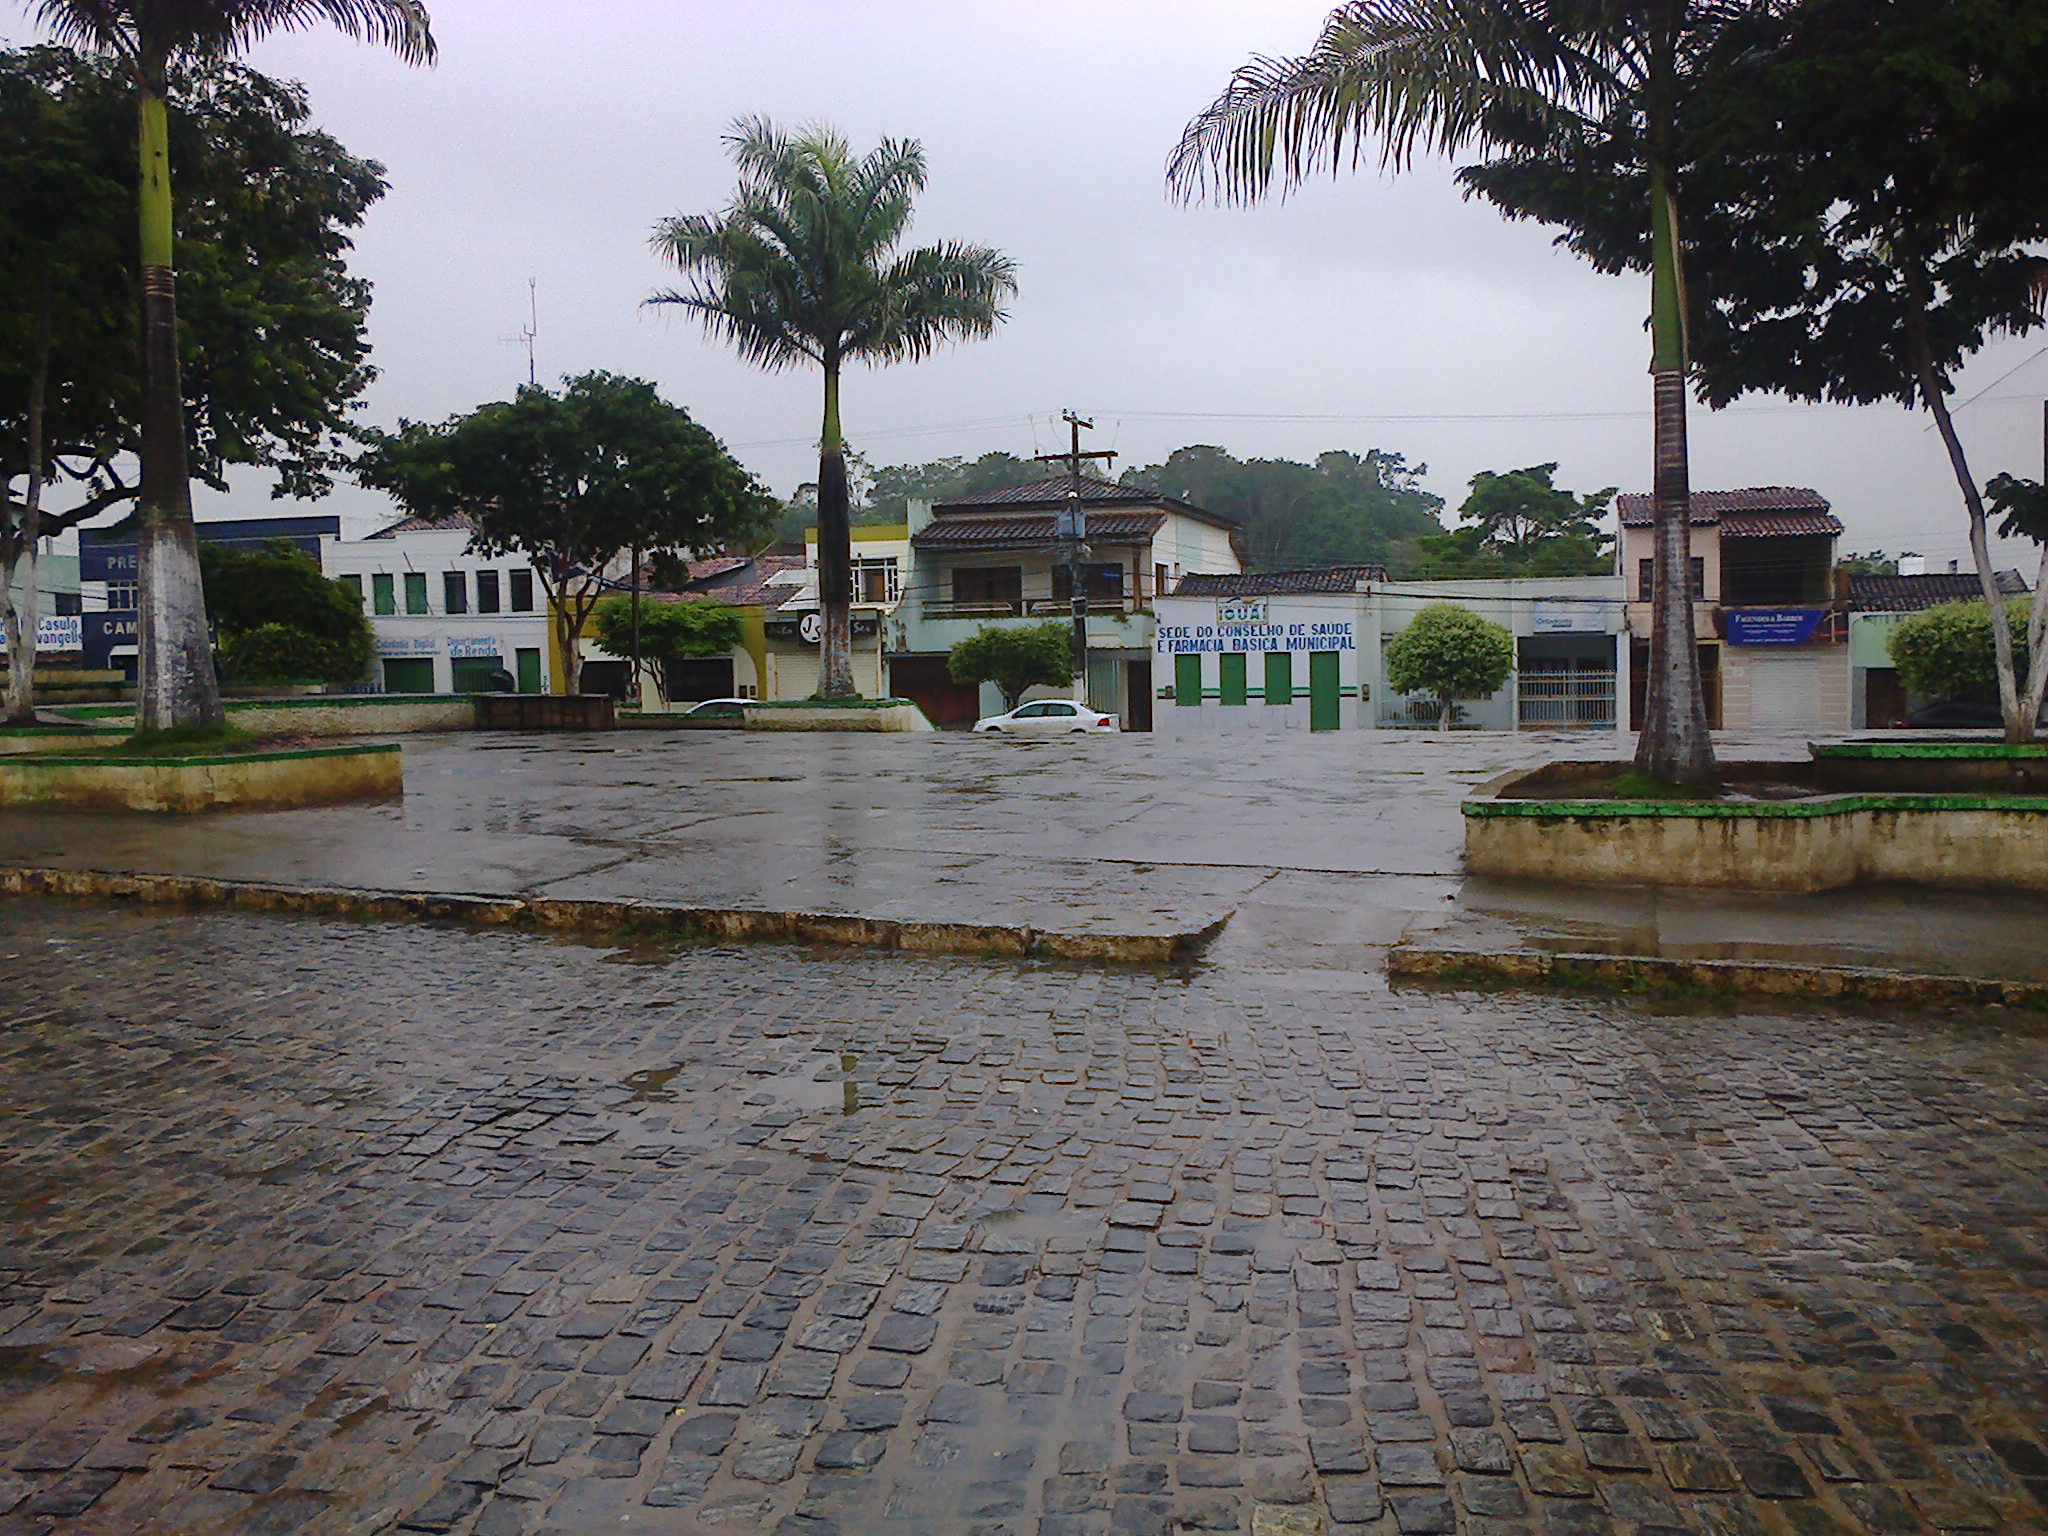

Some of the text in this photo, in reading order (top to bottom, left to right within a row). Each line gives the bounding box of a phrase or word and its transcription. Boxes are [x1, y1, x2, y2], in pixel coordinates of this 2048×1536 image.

[107, 555, 138, 569] PRE
[38, 616, 78, 631] Casulo
[103, 621, 138, 635] CAM
[1159, 627, 1190, 639] SEDE
[1197, 626, 1213, 638] DO
[1217, 624, 1283, 637] CONSELHO
[1289, 624, 1305, 635] DE
[450, 646, 463, 656] de
[464, 645, 498, 657] Renda
[1157, 640, 1165, 654] E
[1286, 637, 1356, 650] MUNICIPAL
